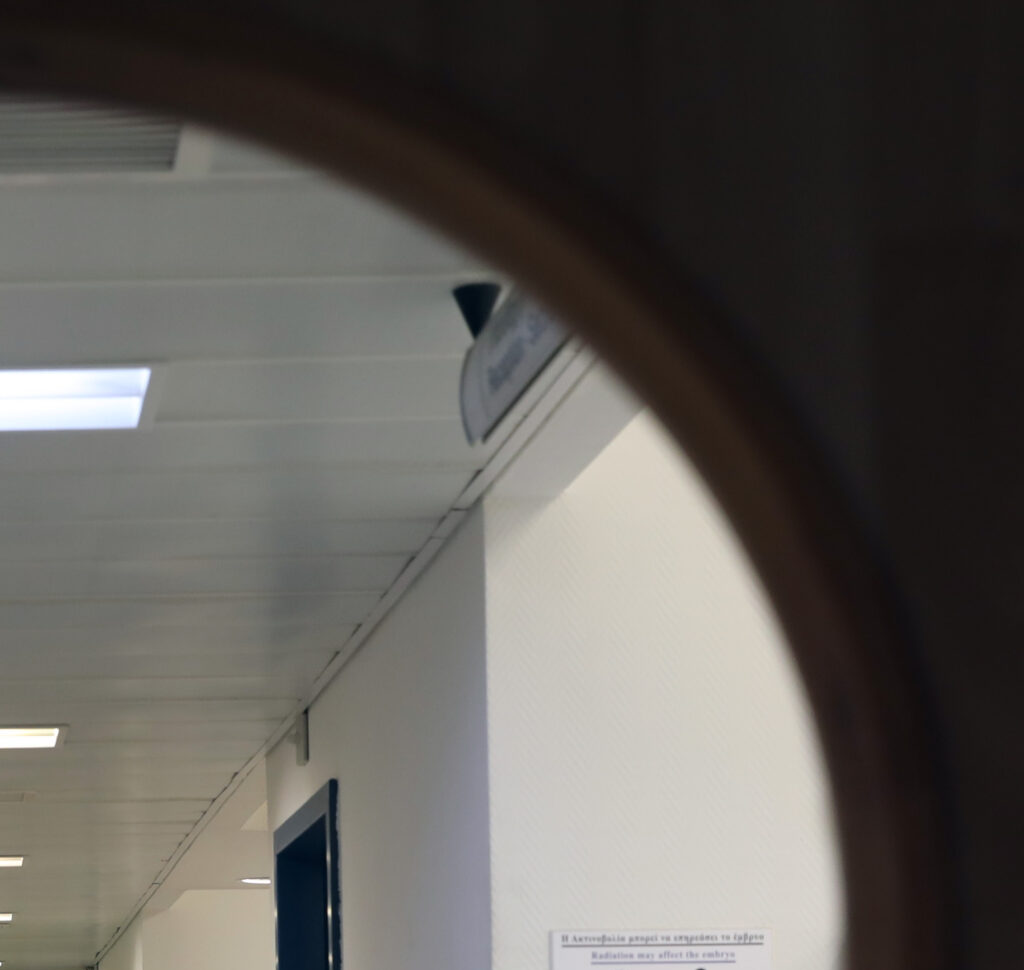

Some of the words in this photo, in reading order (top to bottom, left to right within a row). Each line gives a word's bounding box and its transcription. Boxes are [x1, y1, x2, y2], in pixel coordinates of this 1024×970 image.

[591, 950, 634, 960] Radiation
[637, 952, 654, 961] may
[658, 950, 683, 960] affect
[686, 950, 700, 959] the
[702, 950, 736, 961] embryo
